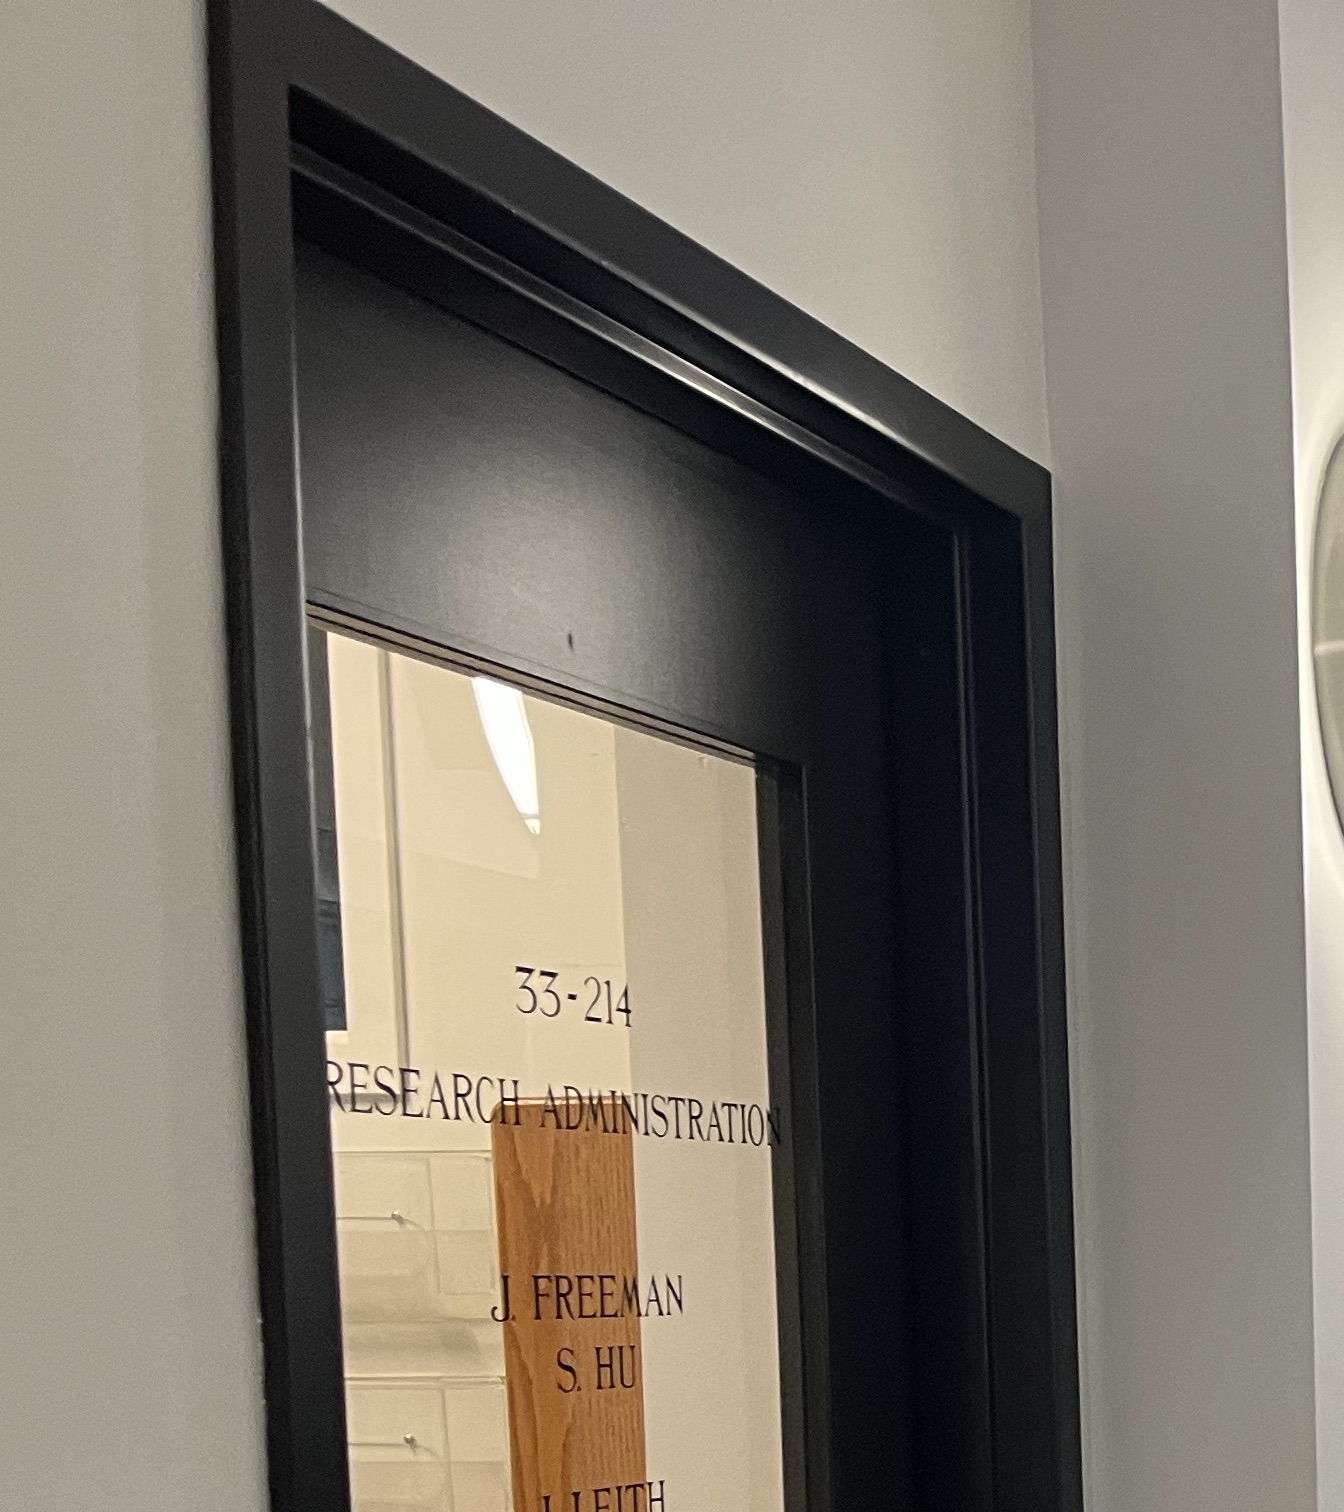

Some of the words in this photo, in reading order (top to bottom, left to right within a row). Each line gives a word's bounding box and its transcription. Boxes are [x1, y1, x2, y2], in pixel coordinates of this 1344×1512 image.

[515, 966, 632, 1028] 33-214
[326, 1060, 521, 1126] RESEARCH
[539, 1083, 781, 1147] ADMINISTRATION
[490, 1274, 517, 1323] J.
[532, 1274, 684, 1321] FREEMAN
[556, 1347, 582, 1394] S.
[595, 1345, 636, 1390] HU
